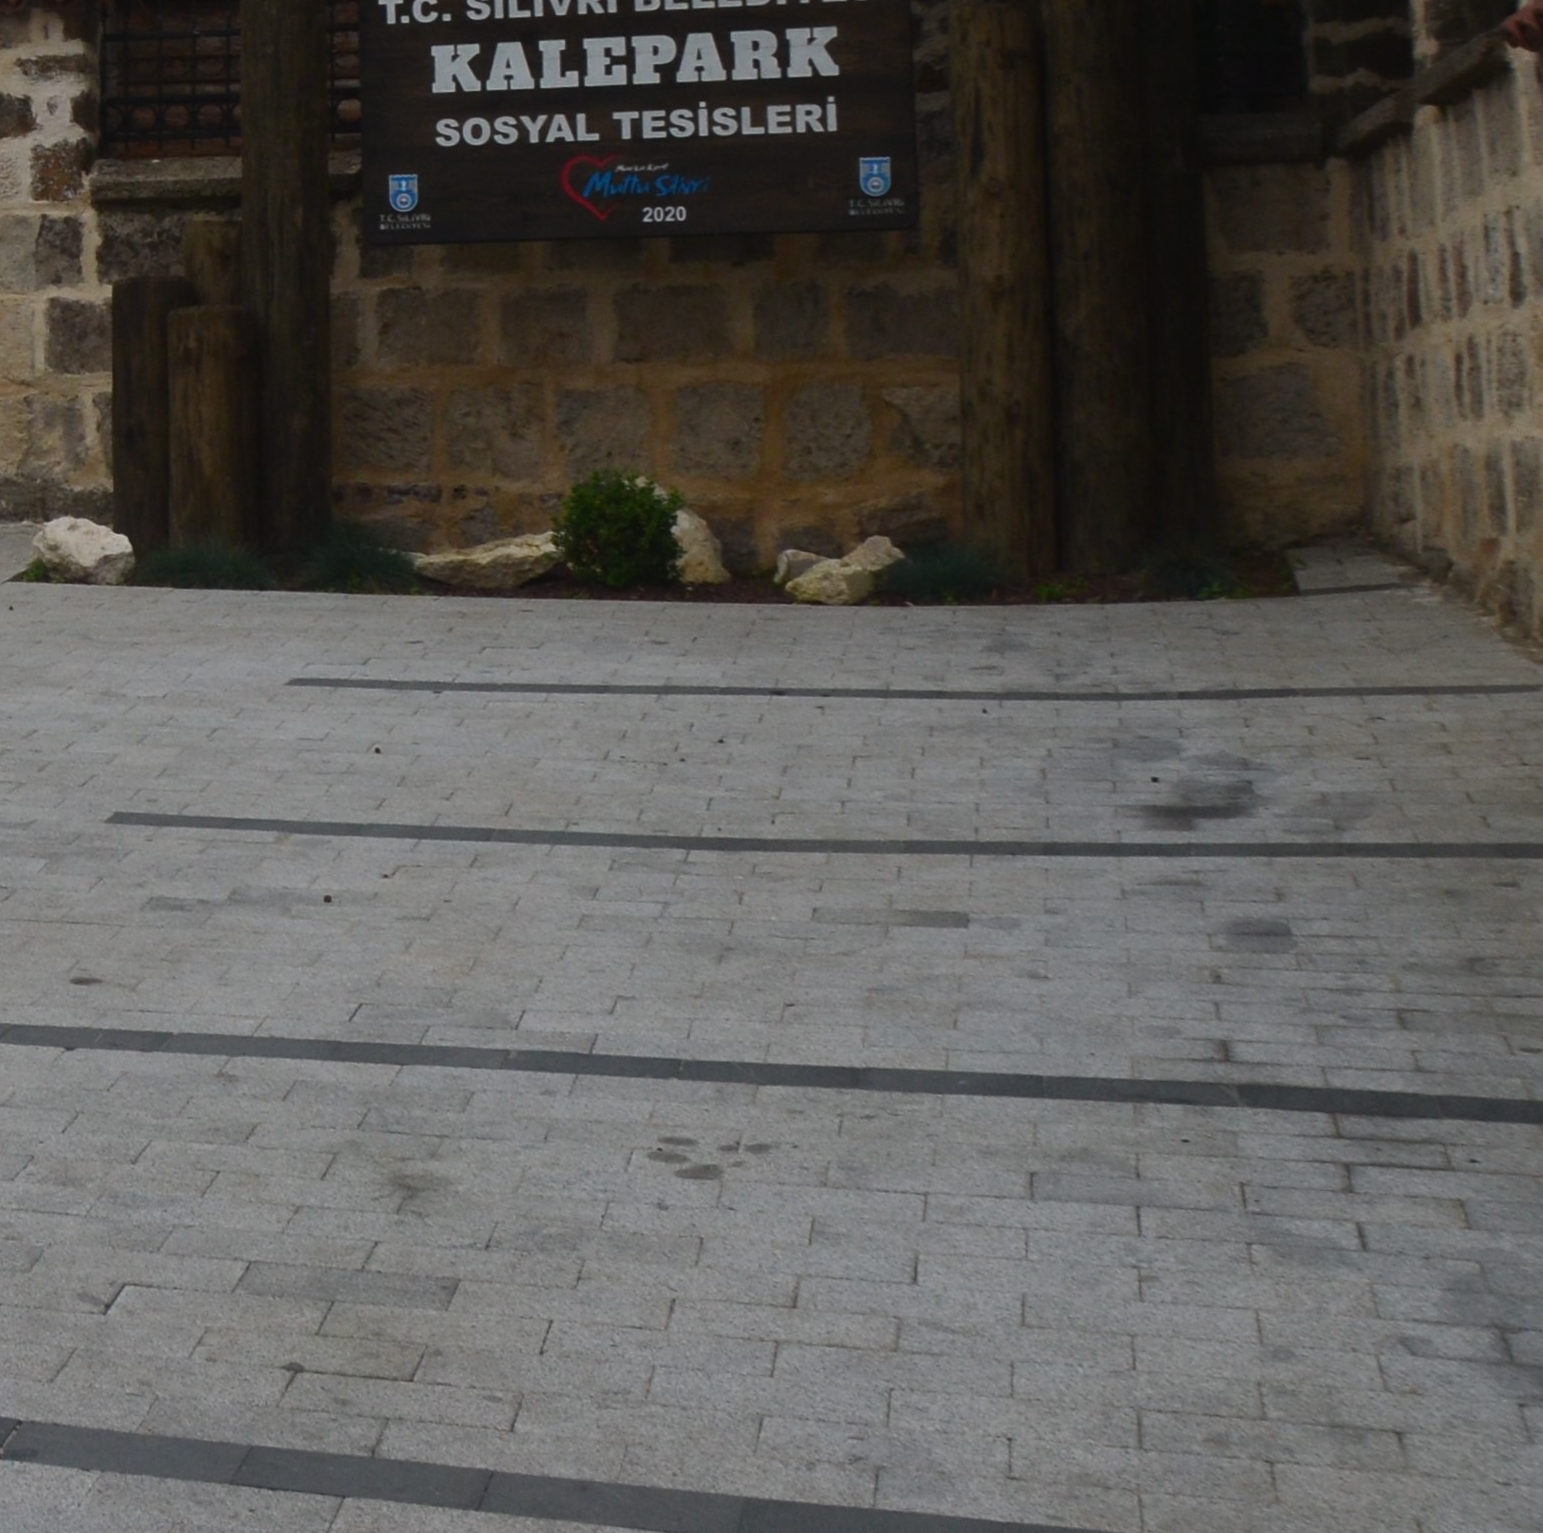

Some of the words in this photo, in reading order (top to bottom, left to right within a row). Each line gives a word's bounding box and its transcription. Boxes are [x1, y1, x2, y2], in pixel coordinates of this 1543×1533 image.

[430, 25, 840, 94] KALEPARK
[435, 113, 600, 147] SOSYAL
[613, 96, 837, 140] TESİSLERİ
[642, 205, 687, 223] 2020
